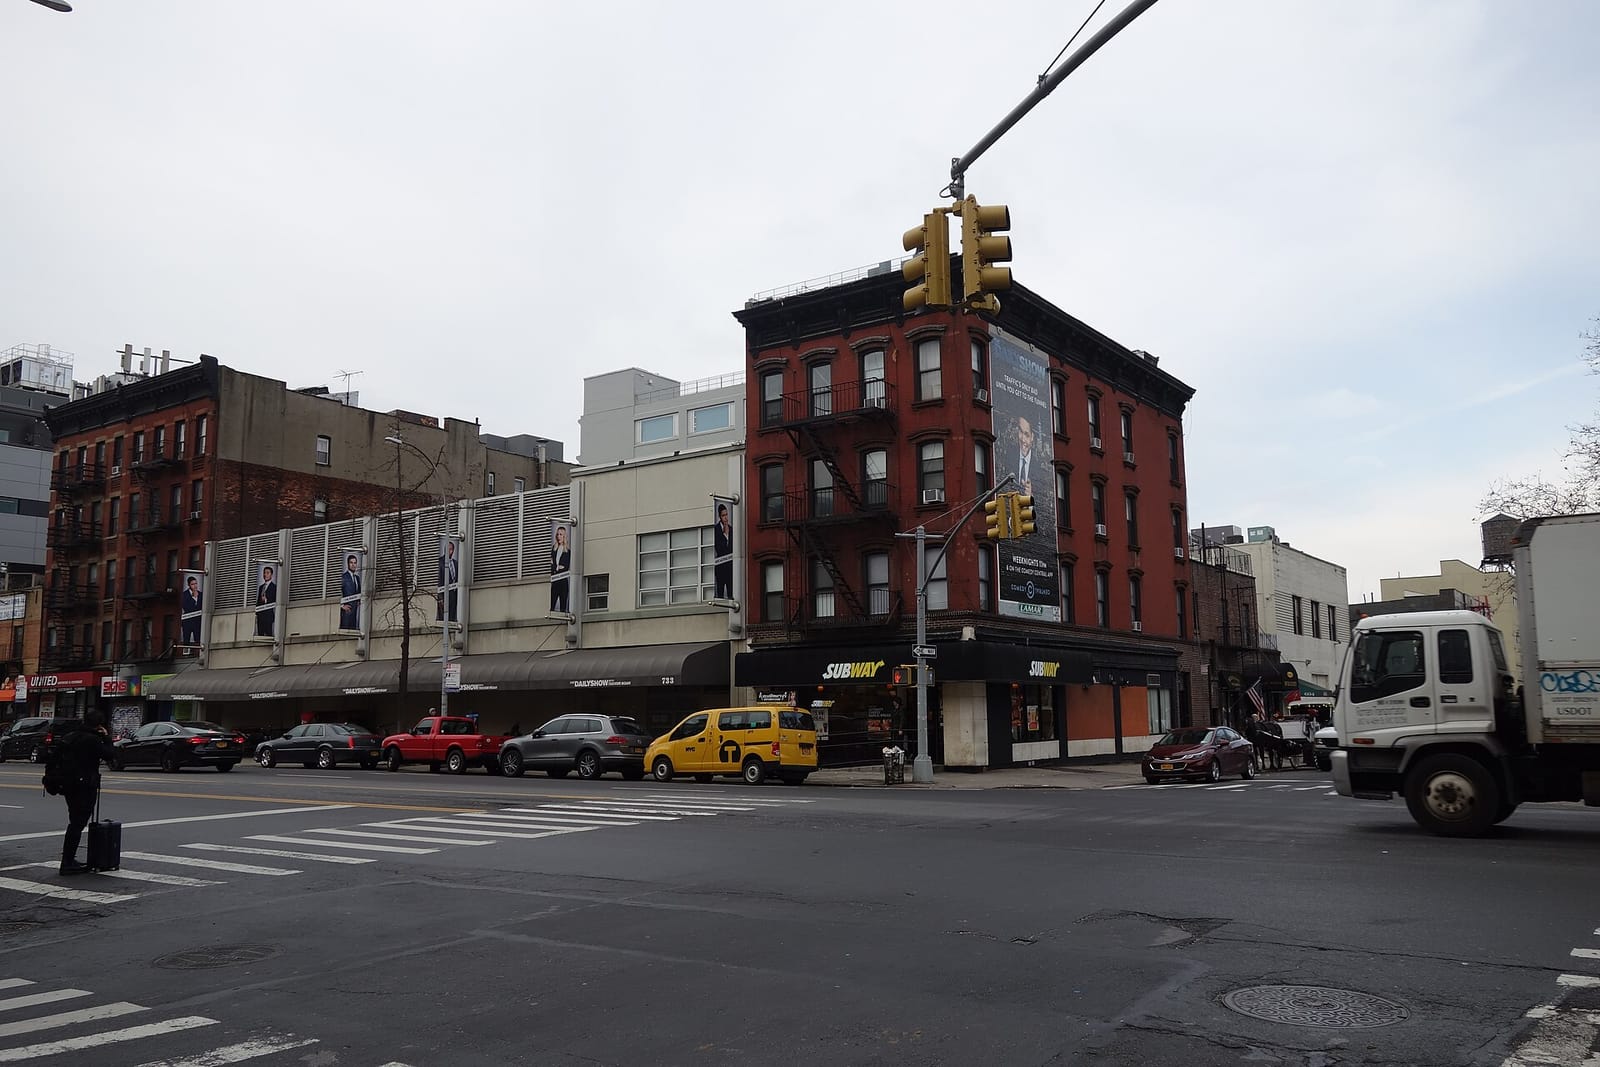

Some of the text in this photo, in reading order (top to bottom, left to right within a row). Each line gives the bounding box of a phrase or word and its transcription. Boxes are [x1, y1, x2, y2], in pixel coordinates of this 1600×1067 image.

[822, 660, 885, 680] SUBWAY
[1029, 661, 1060, 677] SUBWAY
[30, 676, 58, 686] UNITED
[661, 677, 674, 685] 733
